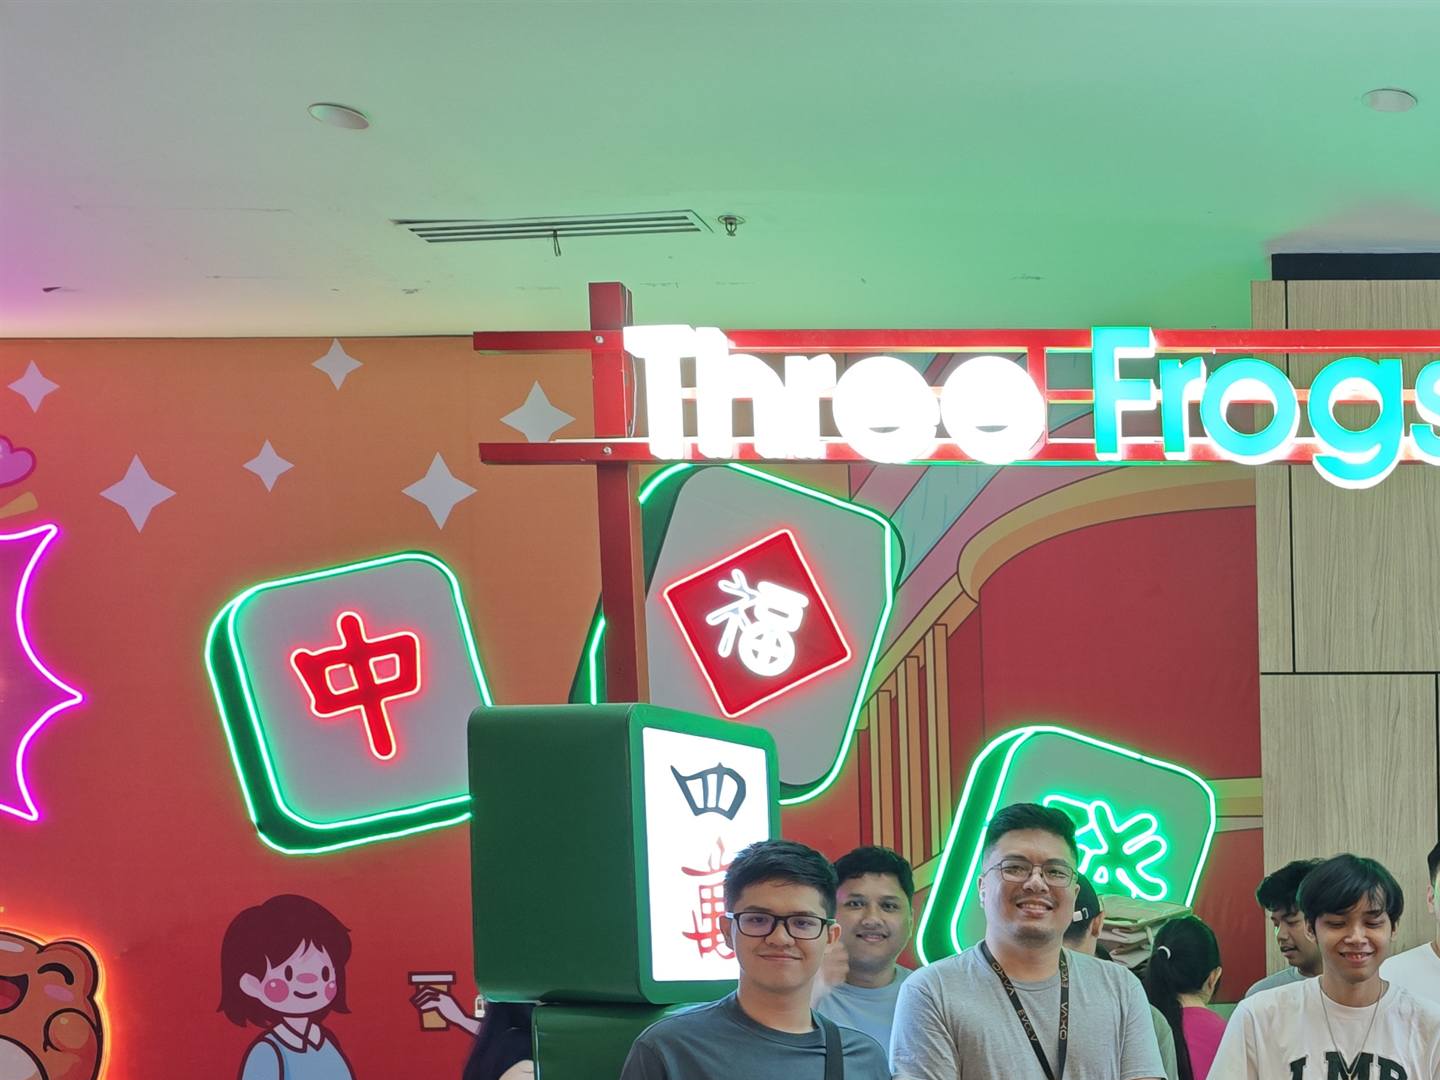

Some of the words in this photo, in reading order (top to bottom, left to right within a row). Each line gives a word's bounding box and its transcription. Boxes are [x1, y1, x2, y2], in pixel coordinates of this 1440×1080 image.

[622, 325, 1046, 464] Three
[290, 611, 422, 760] 中
[705, 568, 810, 677] 福
